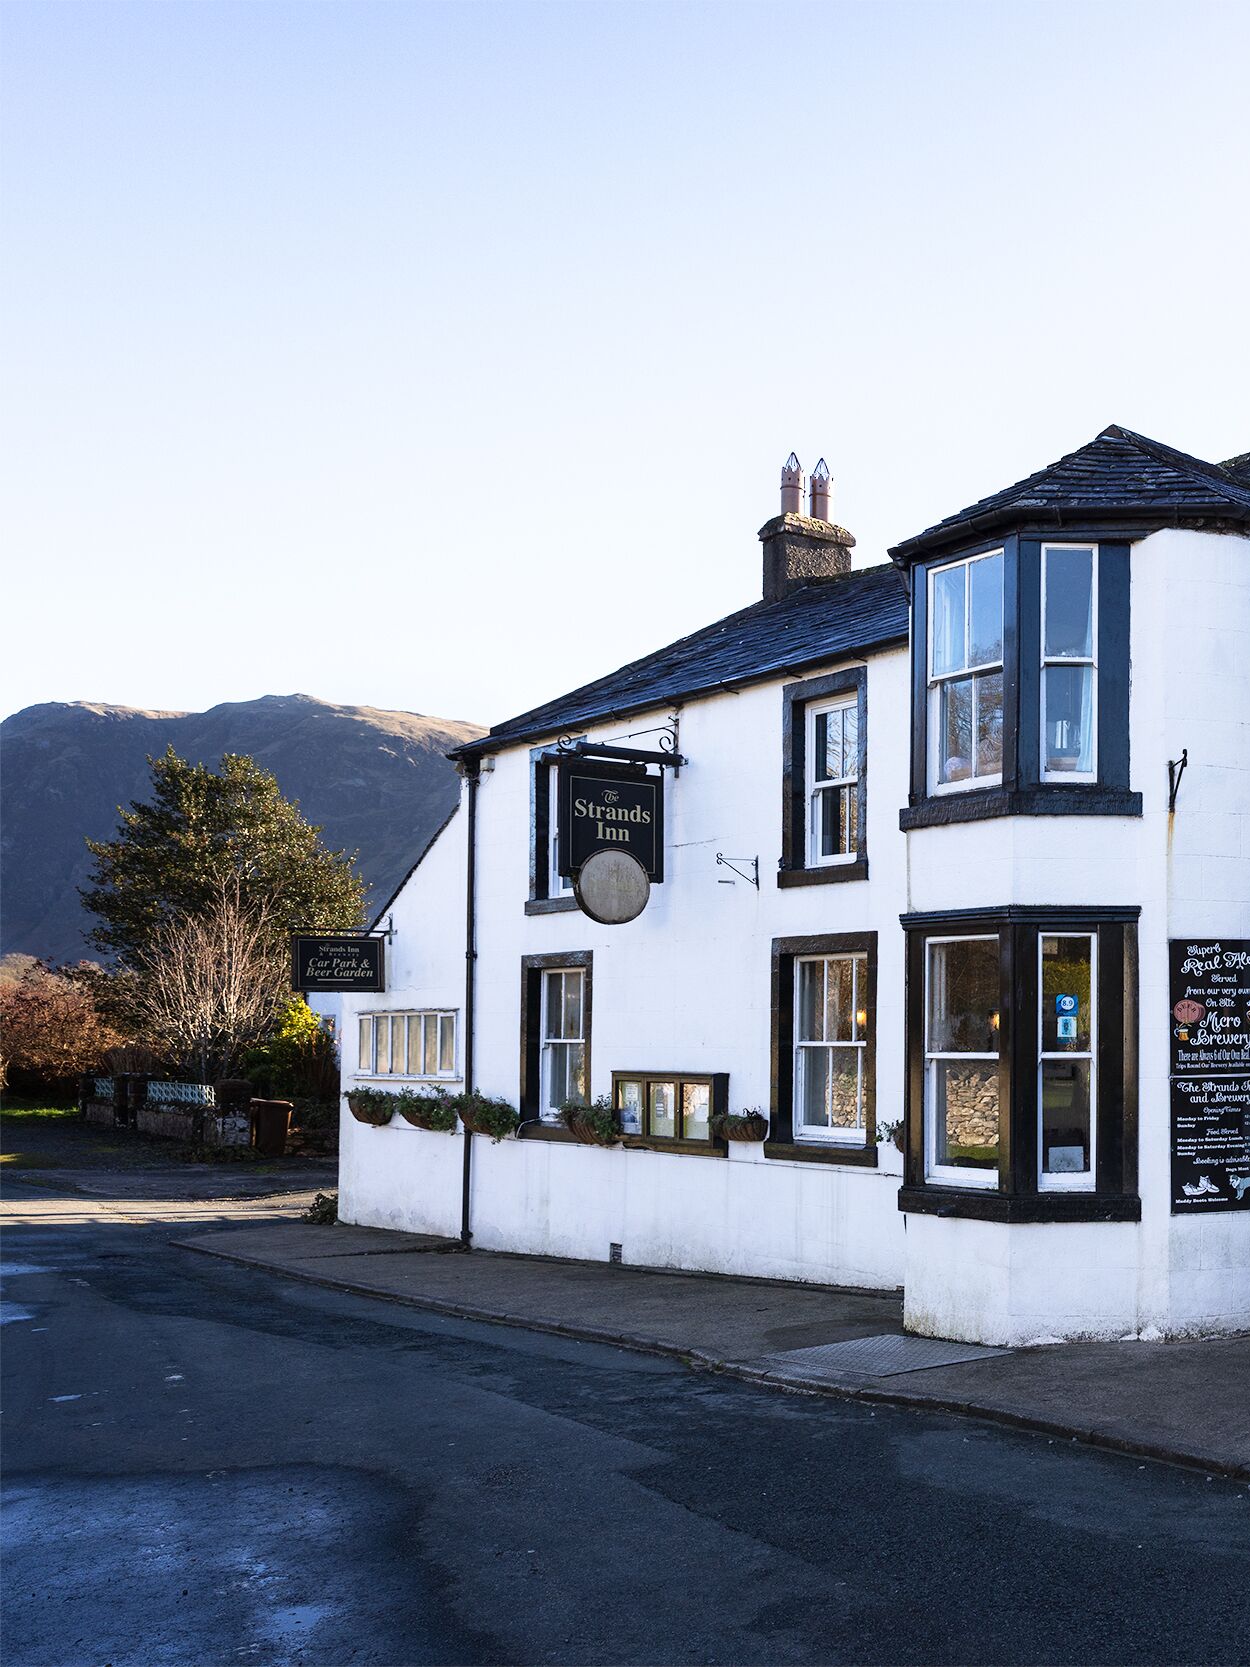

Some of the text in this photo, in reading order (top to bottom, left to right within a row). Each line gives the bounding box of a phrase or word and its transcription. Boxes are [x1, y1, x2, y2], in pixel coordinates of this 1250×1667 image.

[601, 789, 620, 804] The
[574, 798, 651, 824] Strands
[596, 821, 630, 842] Inn
[1187, 943, 1221, 958] Superb
[308, 957, 371, 968] Car Park &
[1181, 955, 1223, 977] Real
[306, 967, 374, 978] Beer Garden
[1211, 974, 1238, 983] Served
[1185, 986, 1205, 998] from
[1221, 988, 1237, 997] very
[1205, 998, 1236, 1008] On Site
[1200, 1011, 1241, 1033] Micro
[1178, 1049, 1191, 1061] There
[1177, 1081, 1201, 1092] The
[1202, 1081, 1239, 1092] Strands
[1190, 1093, 1209, 1103] and
[1203, 1106, 1225, 1115] Opening
[1193, 1156, 1219, 1166] Booking
